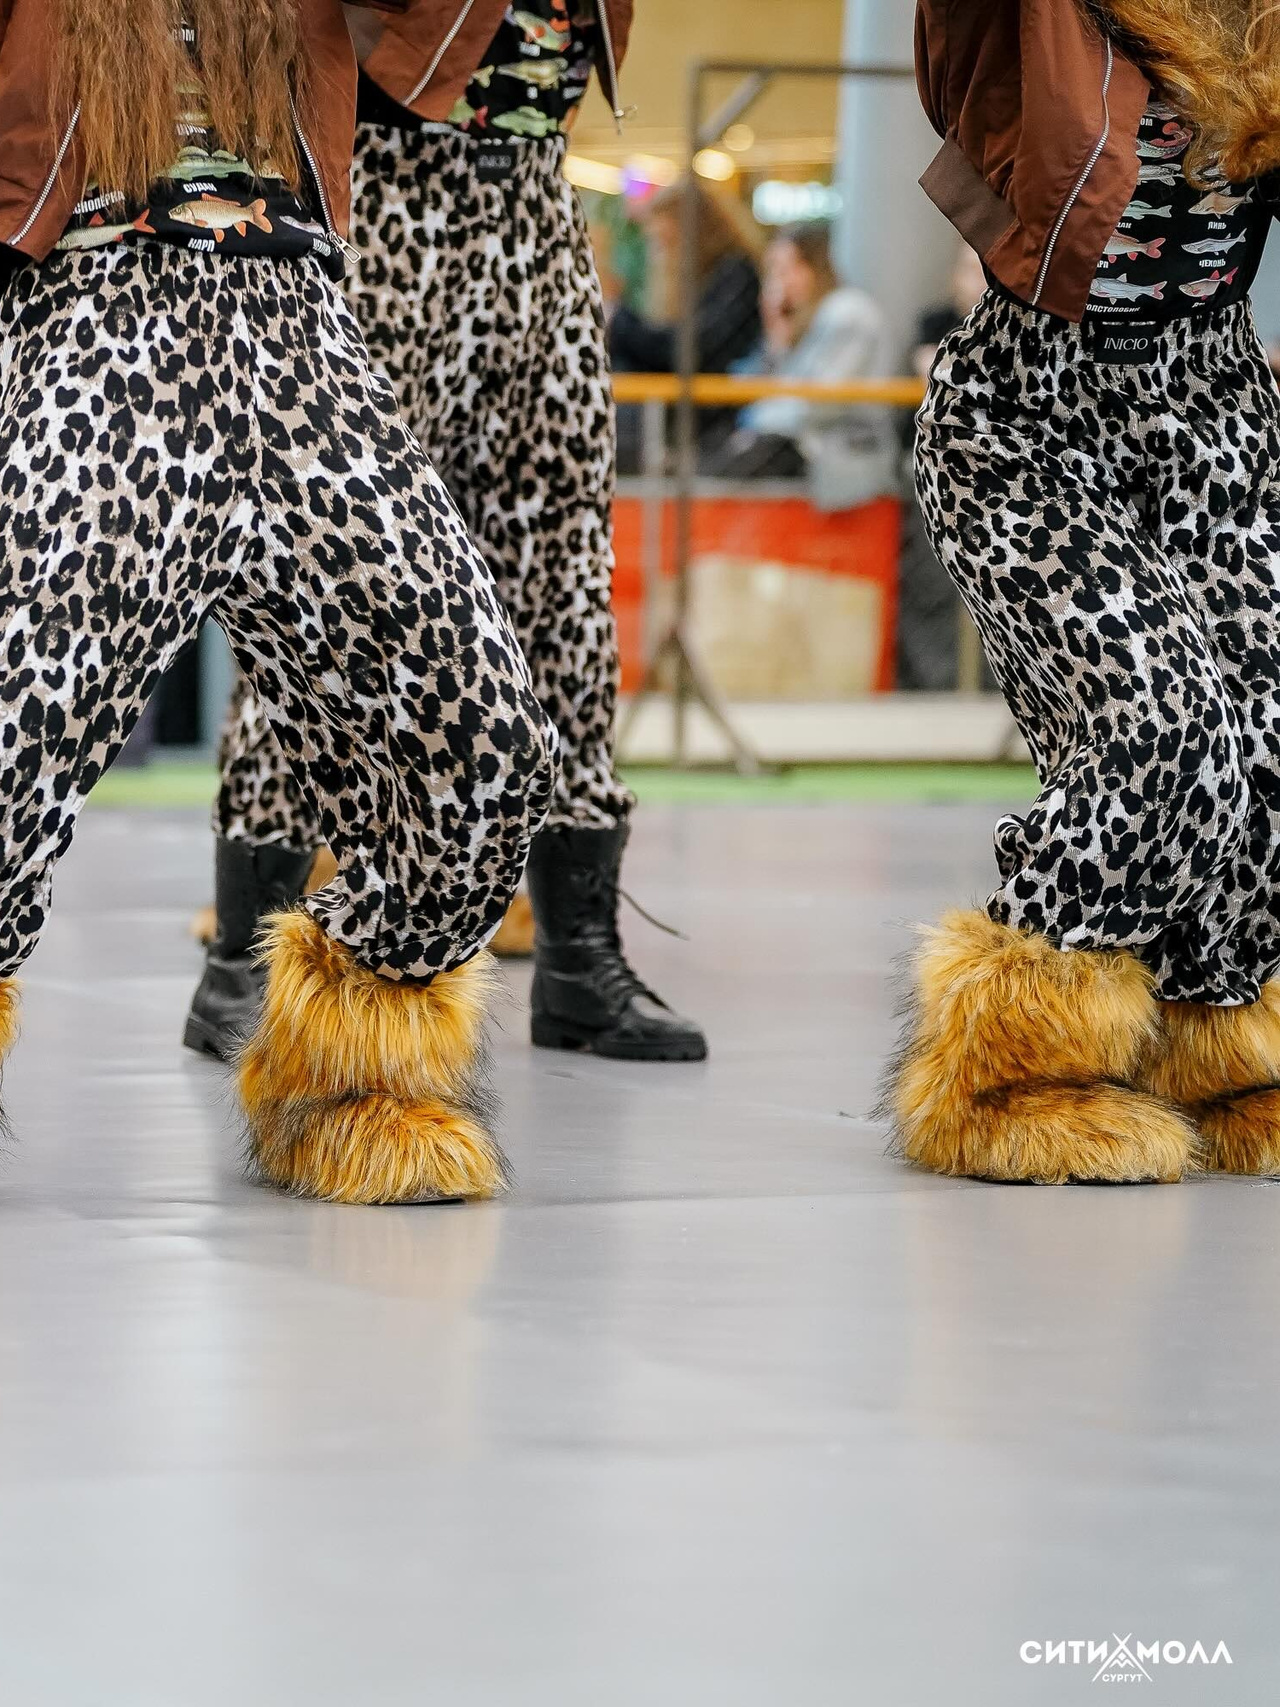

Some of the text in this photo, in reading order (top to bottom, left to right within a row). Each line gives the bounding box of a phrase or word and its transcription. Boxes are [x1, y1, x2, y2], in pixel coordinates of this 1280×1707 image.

[1140, 117, 1153, 127] ОМ
[188, 237, 216, 252] КАРП
[1086, 303, 1141, 313] ОЛСТОЛОБИК
[1103, 337, 1149, 350] INICIO
